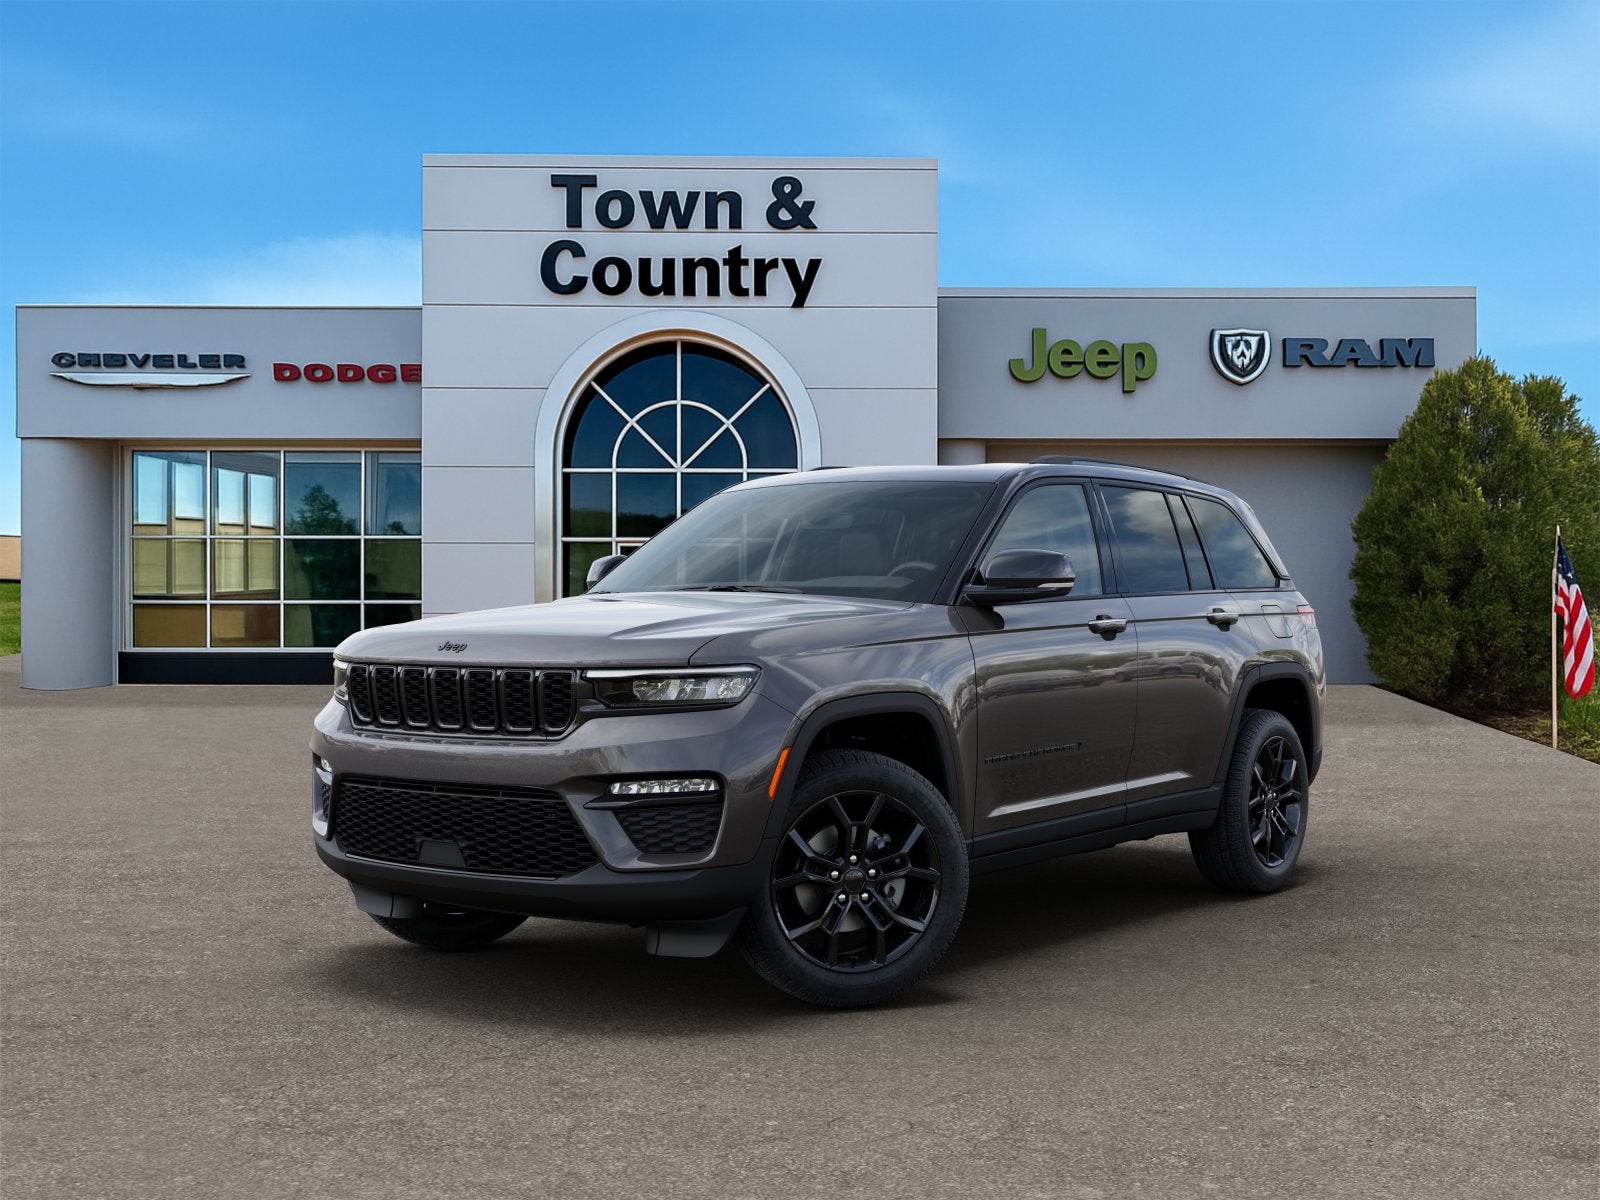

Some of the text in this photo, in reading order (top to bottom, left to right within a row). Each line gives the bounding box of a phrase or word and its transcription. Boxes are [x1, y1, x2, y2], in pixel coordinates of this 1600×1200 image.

[550, 174, 818, 230] Town &
[540, 239, 823, 308] Country
[272, 362, 422, 383] DODGE
[1009, 327, 1158, 393] Jeep
[1282, 337, 1436, 368] RAM
[437, 640, 468, 654] Jeep
